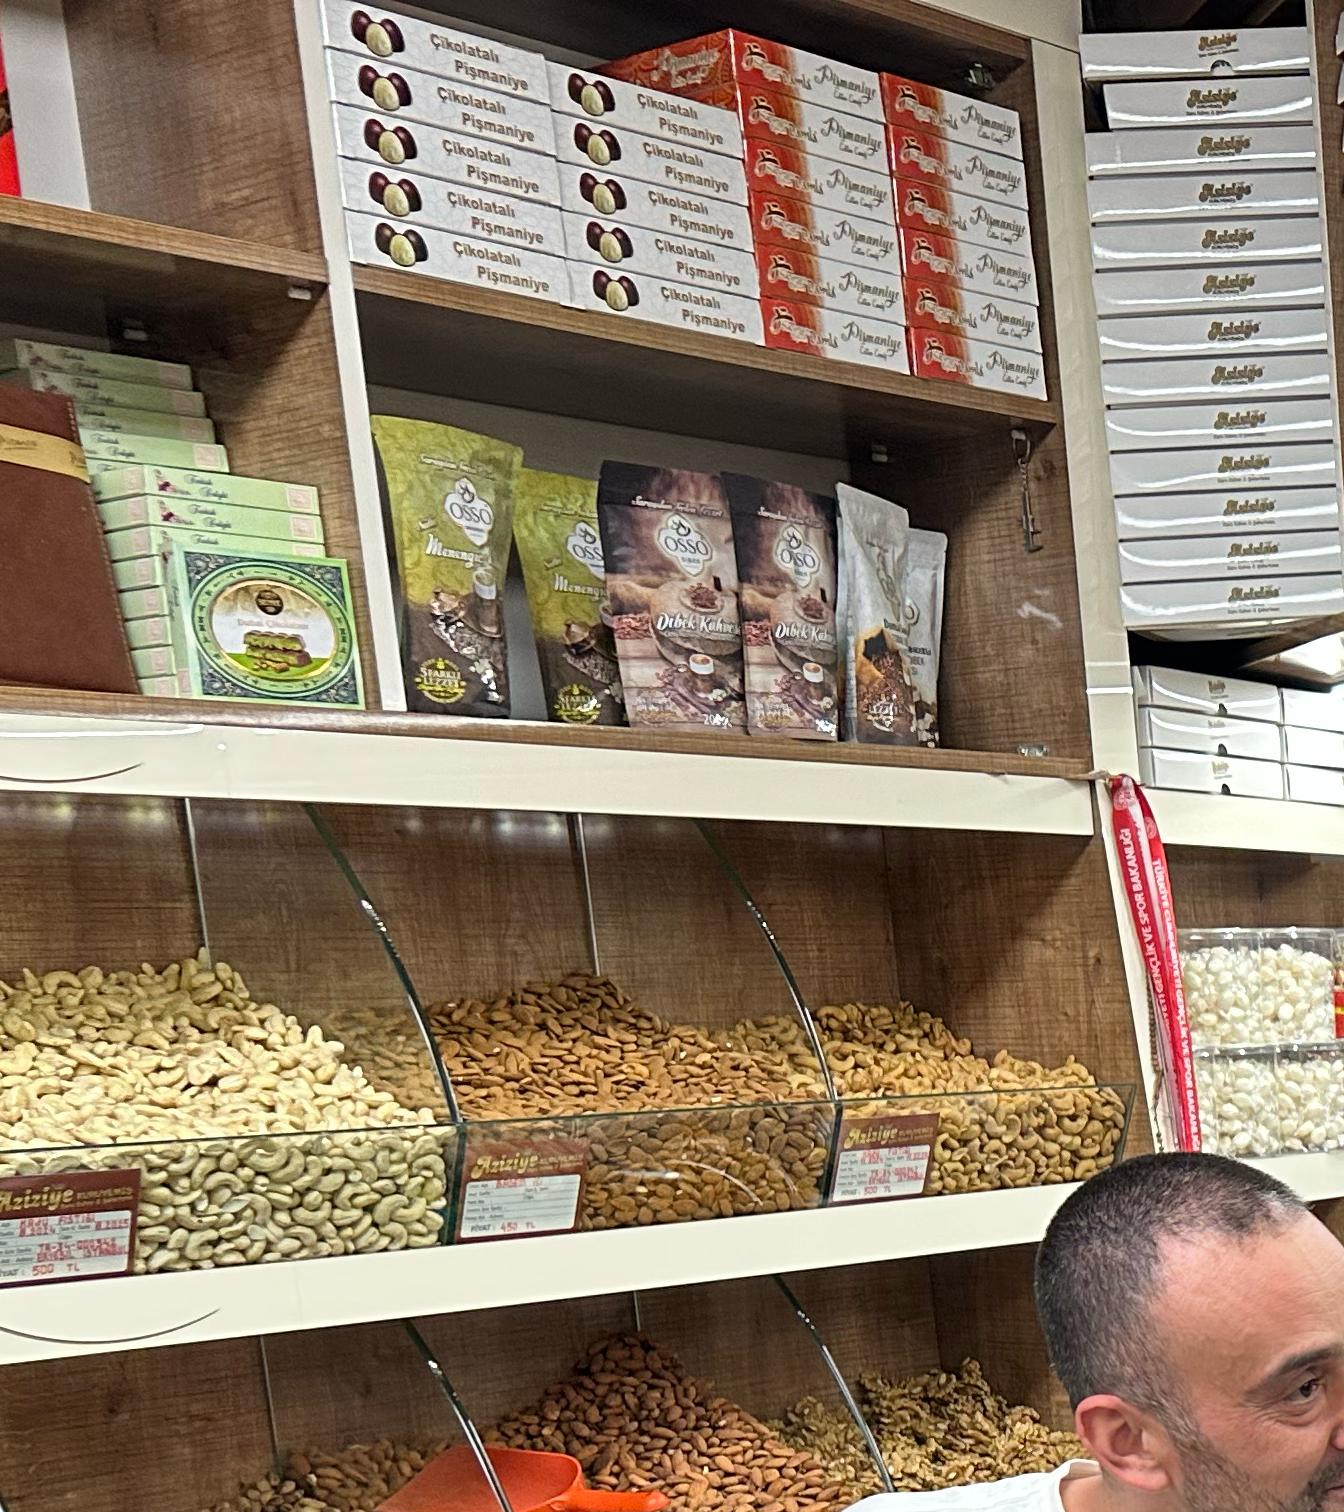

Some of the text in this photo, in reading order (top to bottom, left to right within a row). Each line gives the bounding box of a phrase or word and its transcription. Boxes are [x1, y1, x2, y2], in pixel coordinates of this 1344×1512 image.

[455, 60, 528, 90] Pişmaniye
[461, 112, 535, 141] Pişmaniye
[659, 117, 725, 146] Pişmaniye
[466, 163, 540, 195] Pişmaniye
[664, 165, 730, 194] Pişmaniye
[471, 214, 545, 246] Pişmaniye
[669, 212, 735, 241] Pişmaniye
[477, 263, 550, 294] Pişmaniye
[676, 259, 741, 288] Pişmaniye
[682, 307, 746, 335] Pişmaniye
[450, 502, 491, 525] OSSO
[571, 544, 604, 562] OSS
[664, 536, 710, 555] OSSO
[780, 548, 817, 567] OSSO
[1134, 890, 1152, 926] SPOR
[471, 1152, 538, 1180] Aziziye
[32, 1263, 80, 1276] 500 TL
